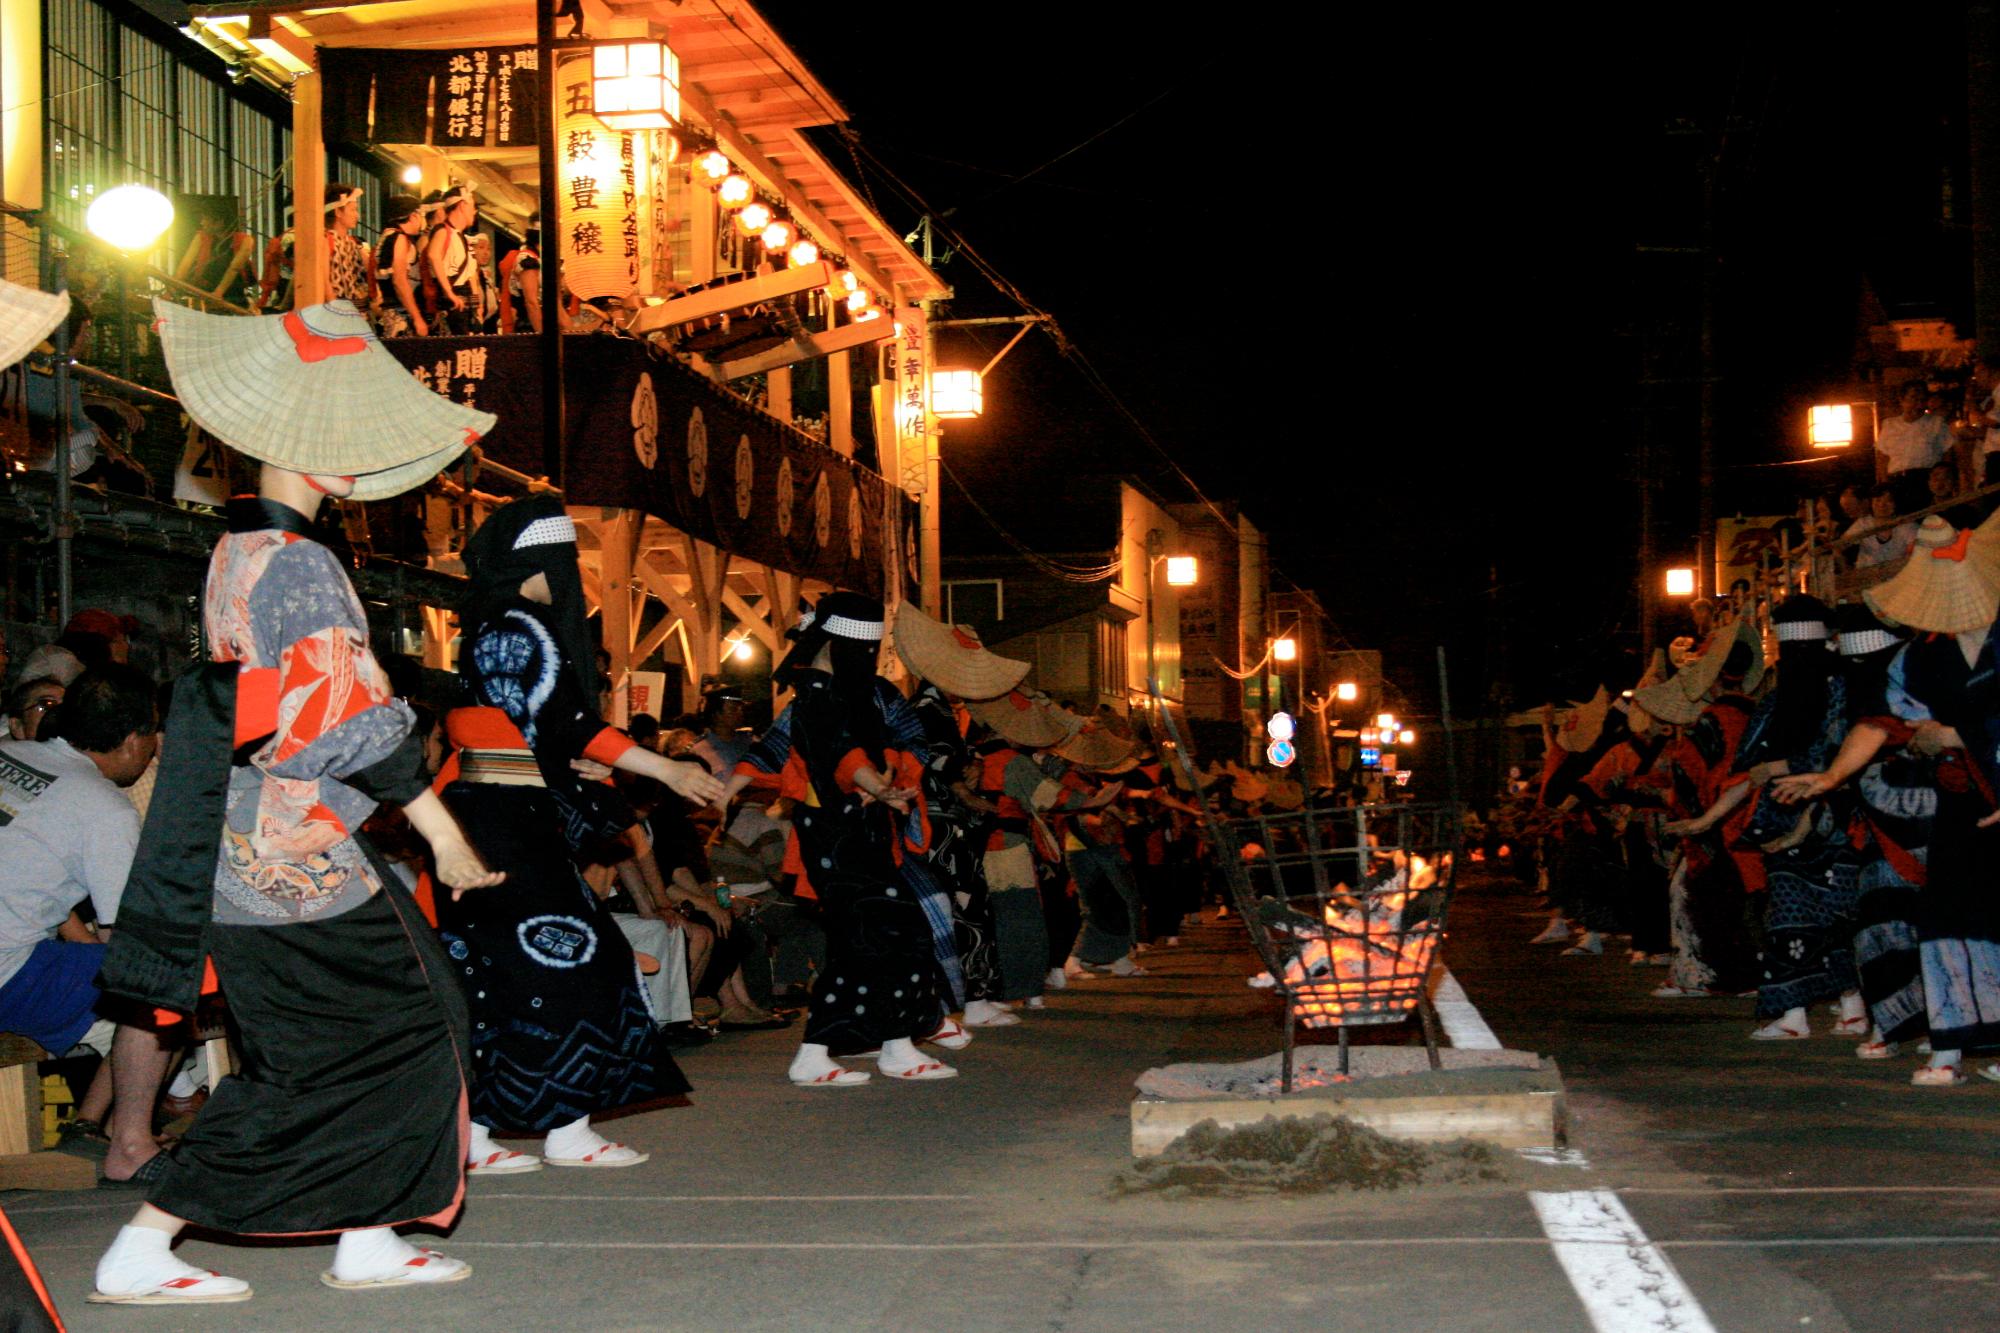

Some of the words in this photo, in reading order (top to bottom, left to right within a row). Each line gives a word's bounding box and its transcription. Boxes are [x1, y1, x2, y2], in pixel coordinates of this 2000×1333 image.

[514, 49, 539, 70] 贈
[448, 54, 473, 138] 北都銀行
[498, 54, 513, 142] 平成十七年八月吉日
[621, 131, 639, 285] 馬音内盆踊り
[434, 360, 452, 400] 創業
[454, 346, 488, 380] 贈
